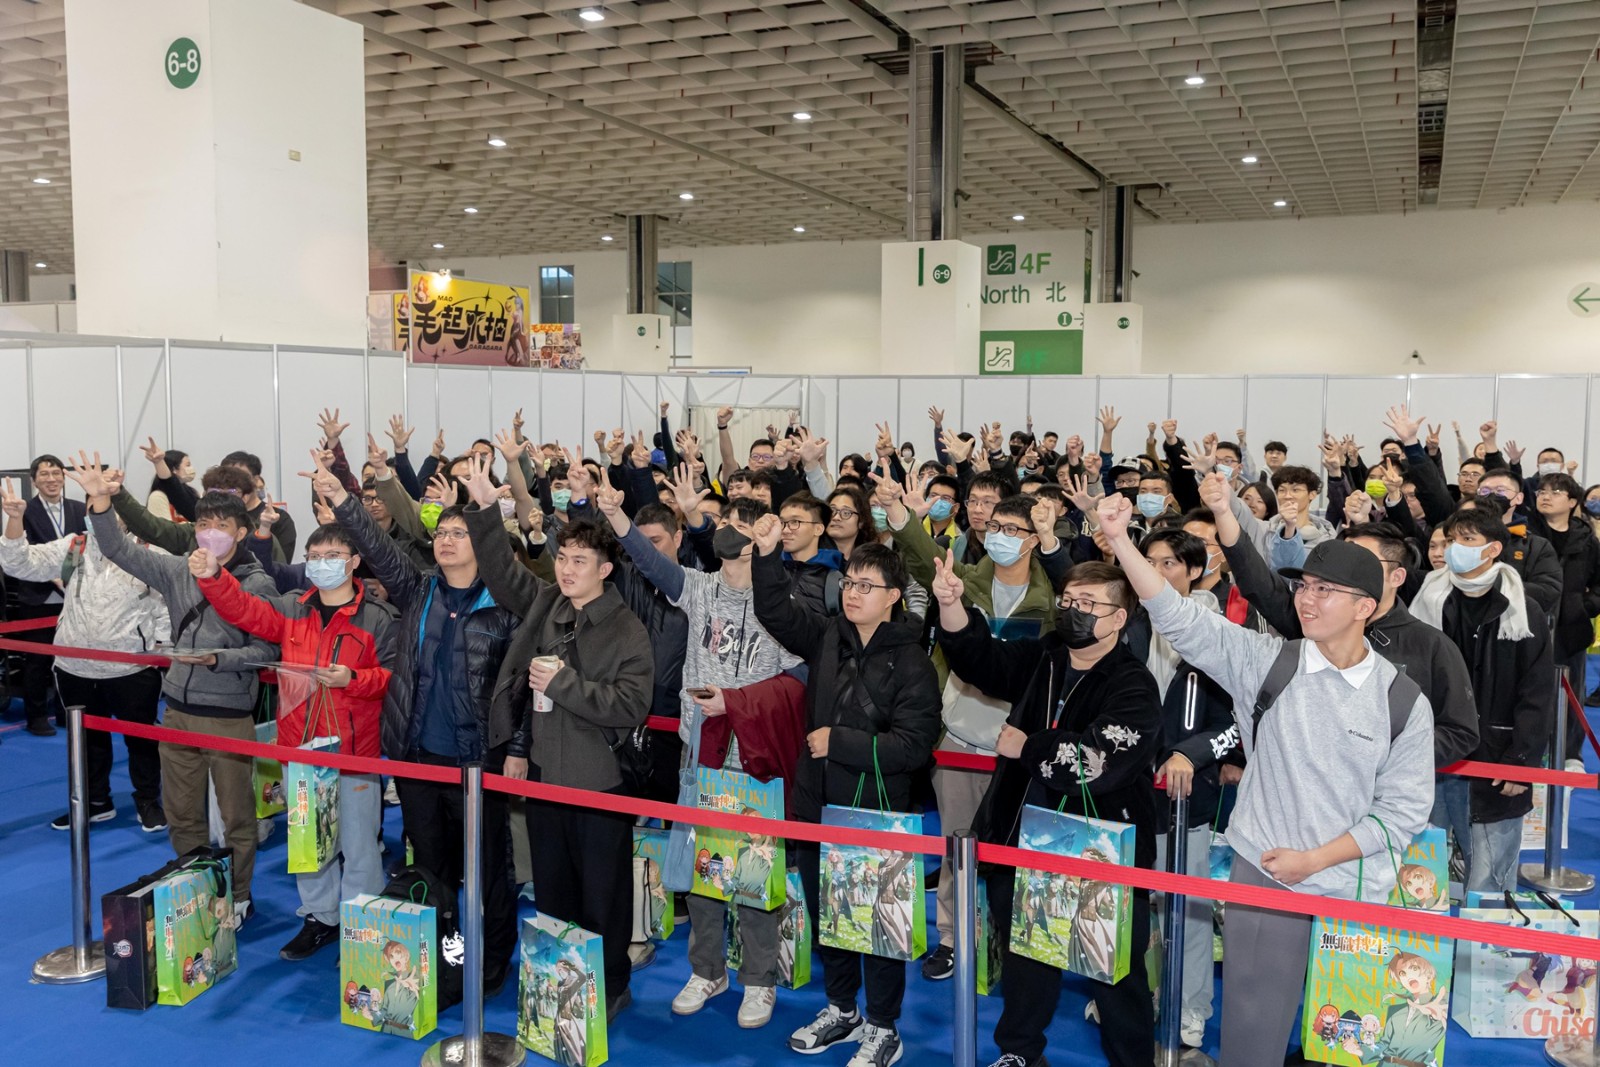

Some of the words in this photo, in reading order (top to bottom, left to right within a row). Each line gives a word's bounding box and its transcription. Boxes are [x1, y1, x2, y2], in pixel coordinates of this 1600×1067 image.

[167, 49, 198, 76] 6-8
[1020, 252, 1052, 274] 4F
[934, 269, 950, 280] 6-9
[981, 284, 1030, 304] North
[1045, 281, 1066, 303] 北
[718, 624, 762, 674] Surf
